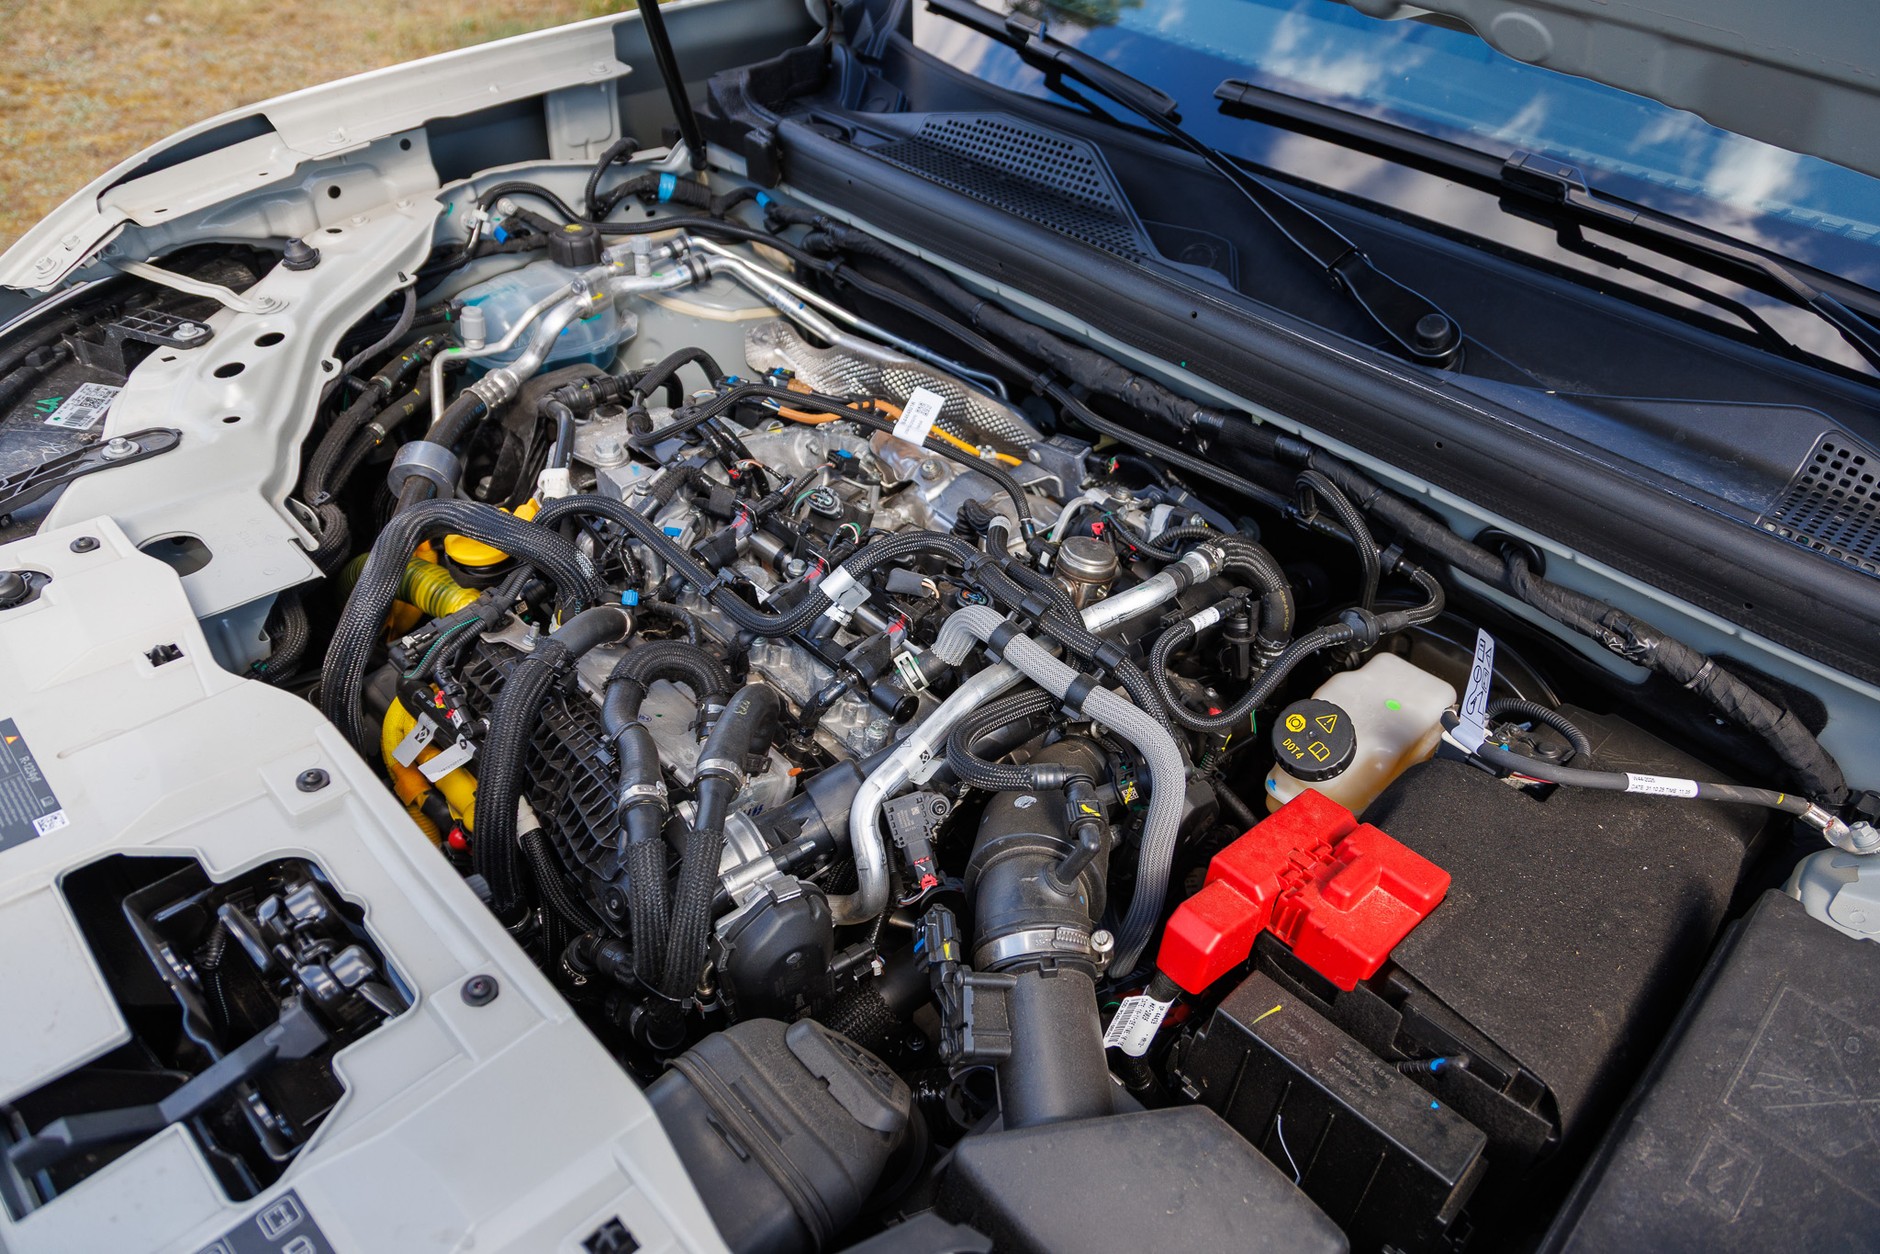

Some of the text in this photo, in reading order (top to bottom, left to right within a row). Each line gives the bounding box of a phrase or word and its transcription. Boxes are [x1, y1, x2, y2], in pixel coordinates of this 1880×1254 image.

[1282, 738, 1305, 760] DOT 4
[19, 755, 41, 782] R-1234yf
